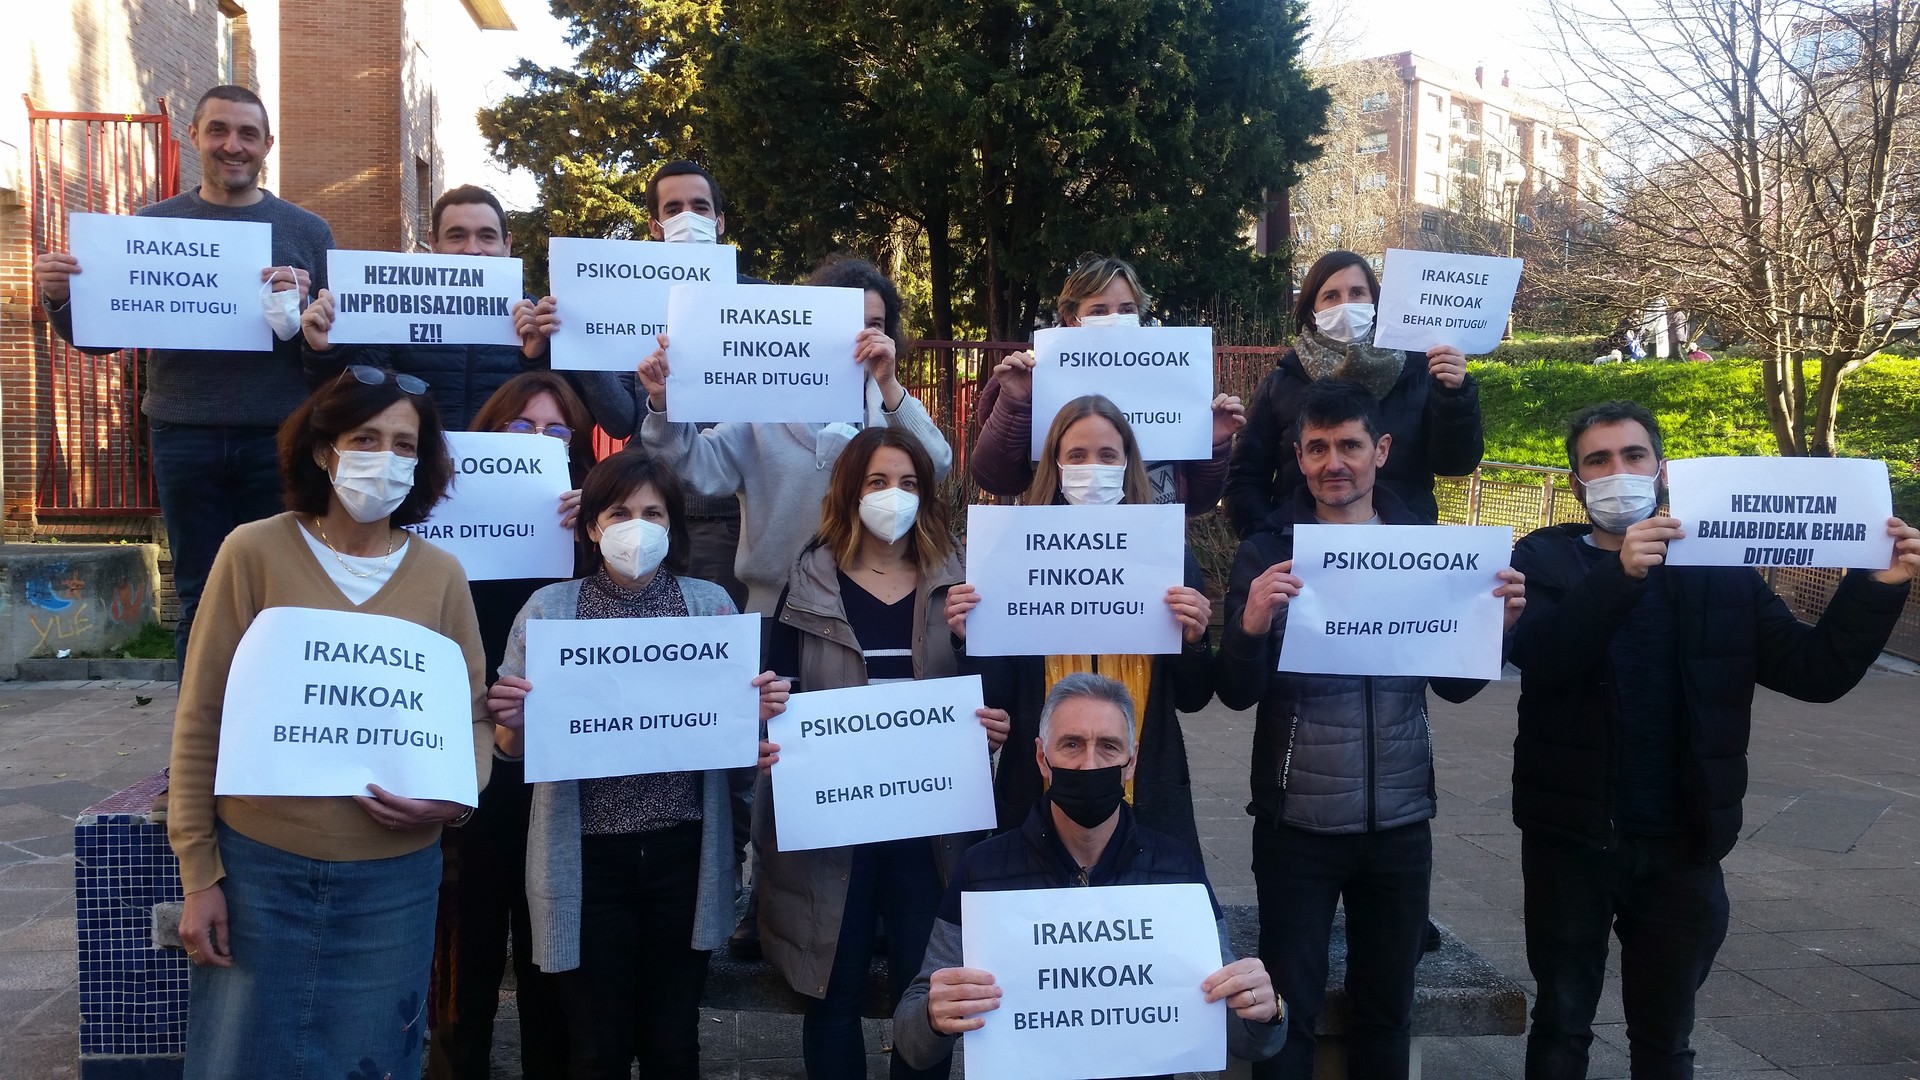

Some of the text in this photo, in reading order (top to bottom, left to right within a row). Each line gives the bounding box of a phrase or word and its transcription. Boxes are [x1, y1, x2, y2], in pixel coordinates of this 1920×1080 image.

[126, 239, 220, 258] IRAKASLE
[129, 270, 218, 288] FINKOAK
[364, 265, 484, 288] HEZKUNTZAN
[576, 262, 711, 282] PSIKOLOGOAK
[1421, 268, 1489, 286] IRAKASLE
[110, 298, 237, 315] BEHAR DITUGU!
[340, 293, 510, 317] INPROBISAZIORIK
[1419, 293, 1483, 309] FINKOAK
[720, 308, 813, 326] IRAKASLE
[1402, 314, 1488, 329] BEHAR DITUGU!
[410, 324, 442, 343] EZ!!
[585, 322, 668, 336] BEHAR DIT
[723, 340, 810, 358] FINKOAK
[1059, 351, 1190, 368] PSIKOLOGOAK
[704, 371, 829, 386] BEHAR DITUGU!
[451, 457, 542, 475] LOGOAK
[1731, 494, 1837, 515] HEZKUNTZAN
[460, 523, 535, 538] DITUGU!
[1697, 520, 1867, 542] BALIABIDEAK BEHAR
[1026, 532, 1127, 551] IRAKASLE
[1322, 551, 1479, 571] PSIKOLOGOAK
[1743, 547, 1814, 566] DITUGU!
[1028, 567, 1125, 586] FINKOAK
[1007, 601, 1144, 616] BEHAR DITUGU!
[1325, 619, 1458, 636] BEHAR DITUGU!
[304, 640, 426, 673] IRAKASLE
[560, 641, 729, 667] PSIKOLOGOAK
[304, 683, 424, 712] FINKOAK
[569, 712, 717, 735] BEHAR DITUGU!
[800, 705, 956, 739] PSIKOLOGOAK
[273, 725, 443, 751] BEHAR DITUGU!
[815, 776, 953, 805] BEHAR DITUGU!
[1033, 918, 1154, 946] IRAKASLE
[1038, 963, 1154, 991] FINKOAK
[1014, 1005, 1179, 1031] BEHAR DITUGU!
